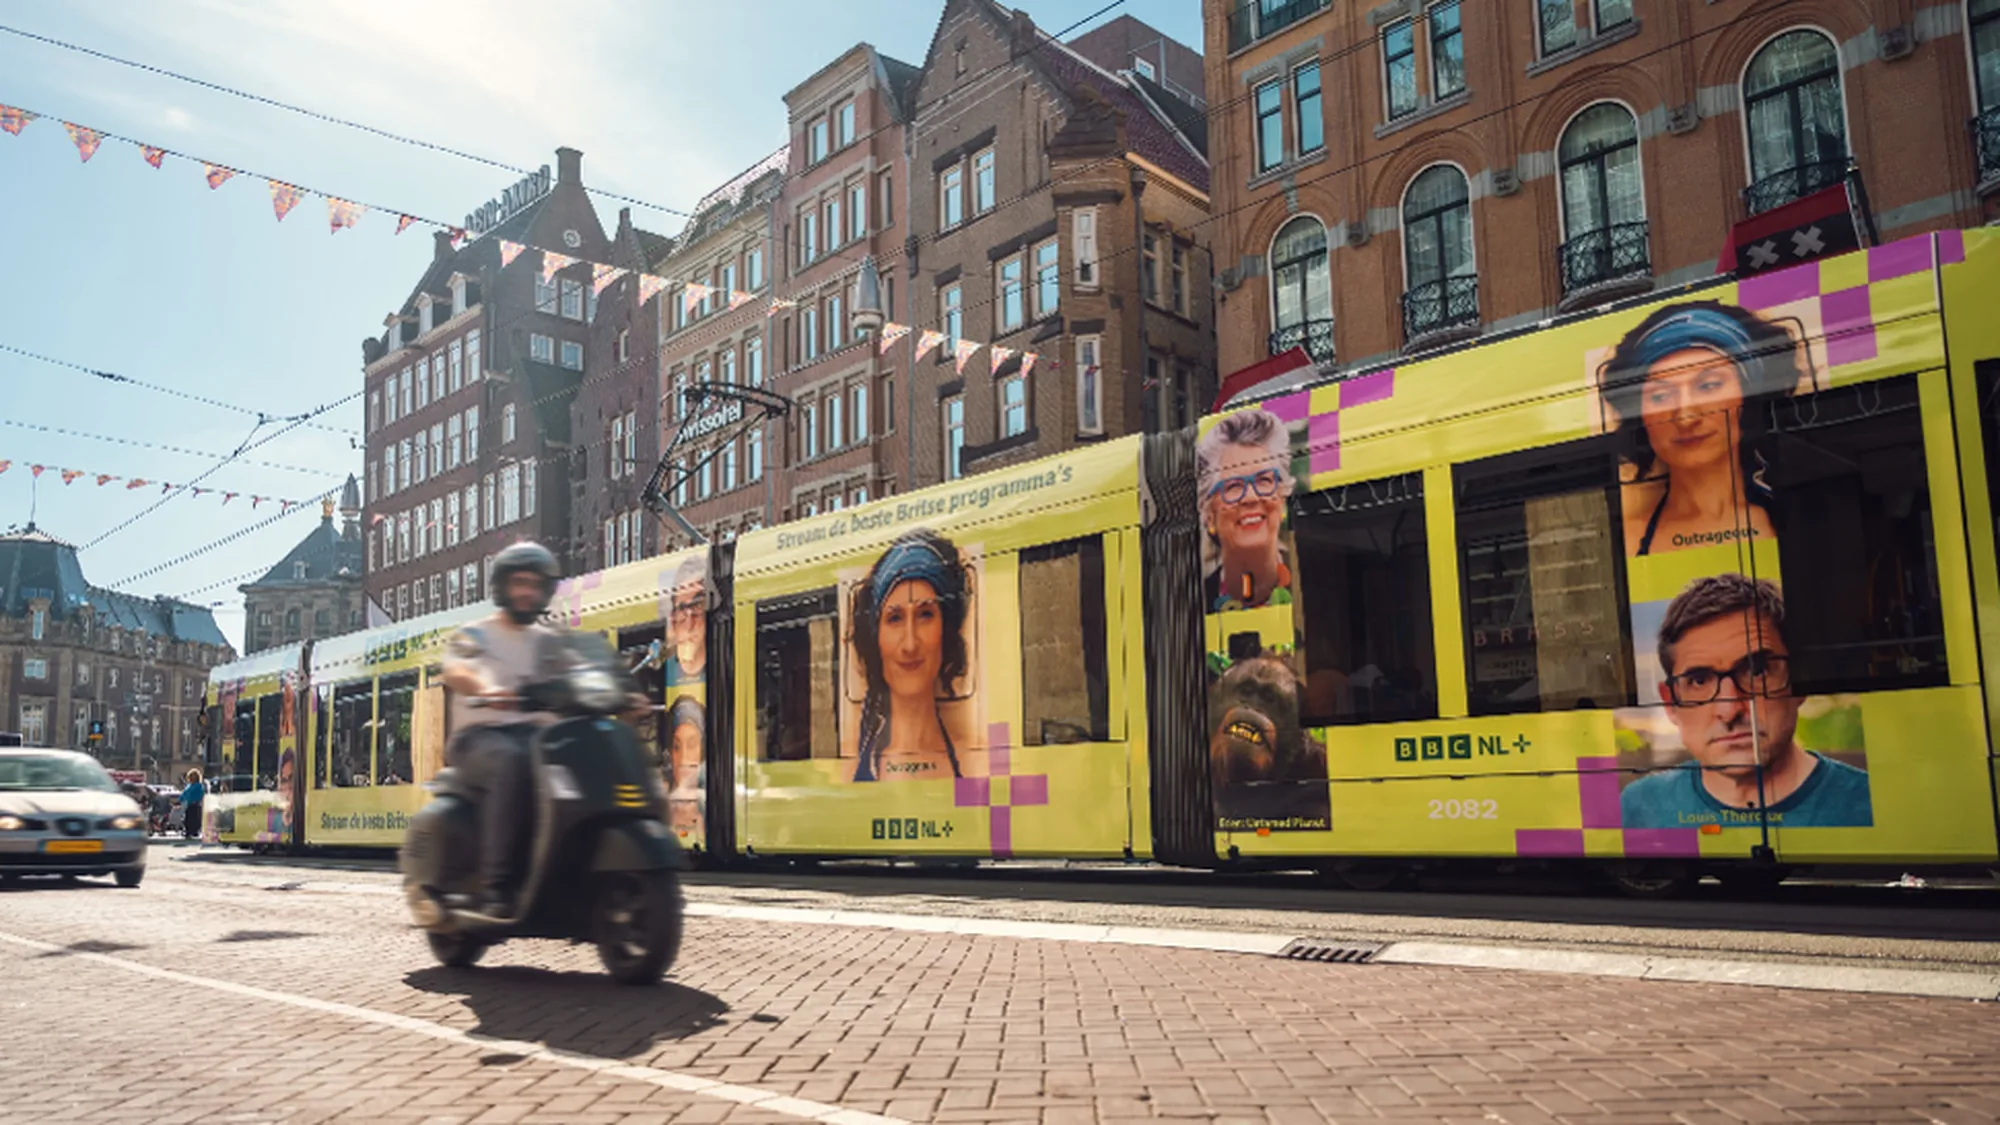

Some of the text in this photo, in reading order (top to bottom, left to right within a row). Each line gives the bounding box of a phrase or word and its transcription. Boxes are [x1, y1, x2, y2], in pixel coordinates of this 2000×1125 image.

[776, 464, 1072, 550] Stream de beste Britse programma's
[1672, 528, 1760, 546] Outrageous
[1394, 733, 1532, 762] BBC NL+
[1428, 798, 1498, 819] 2082
[1678, 809, 1717, 824] Louis
